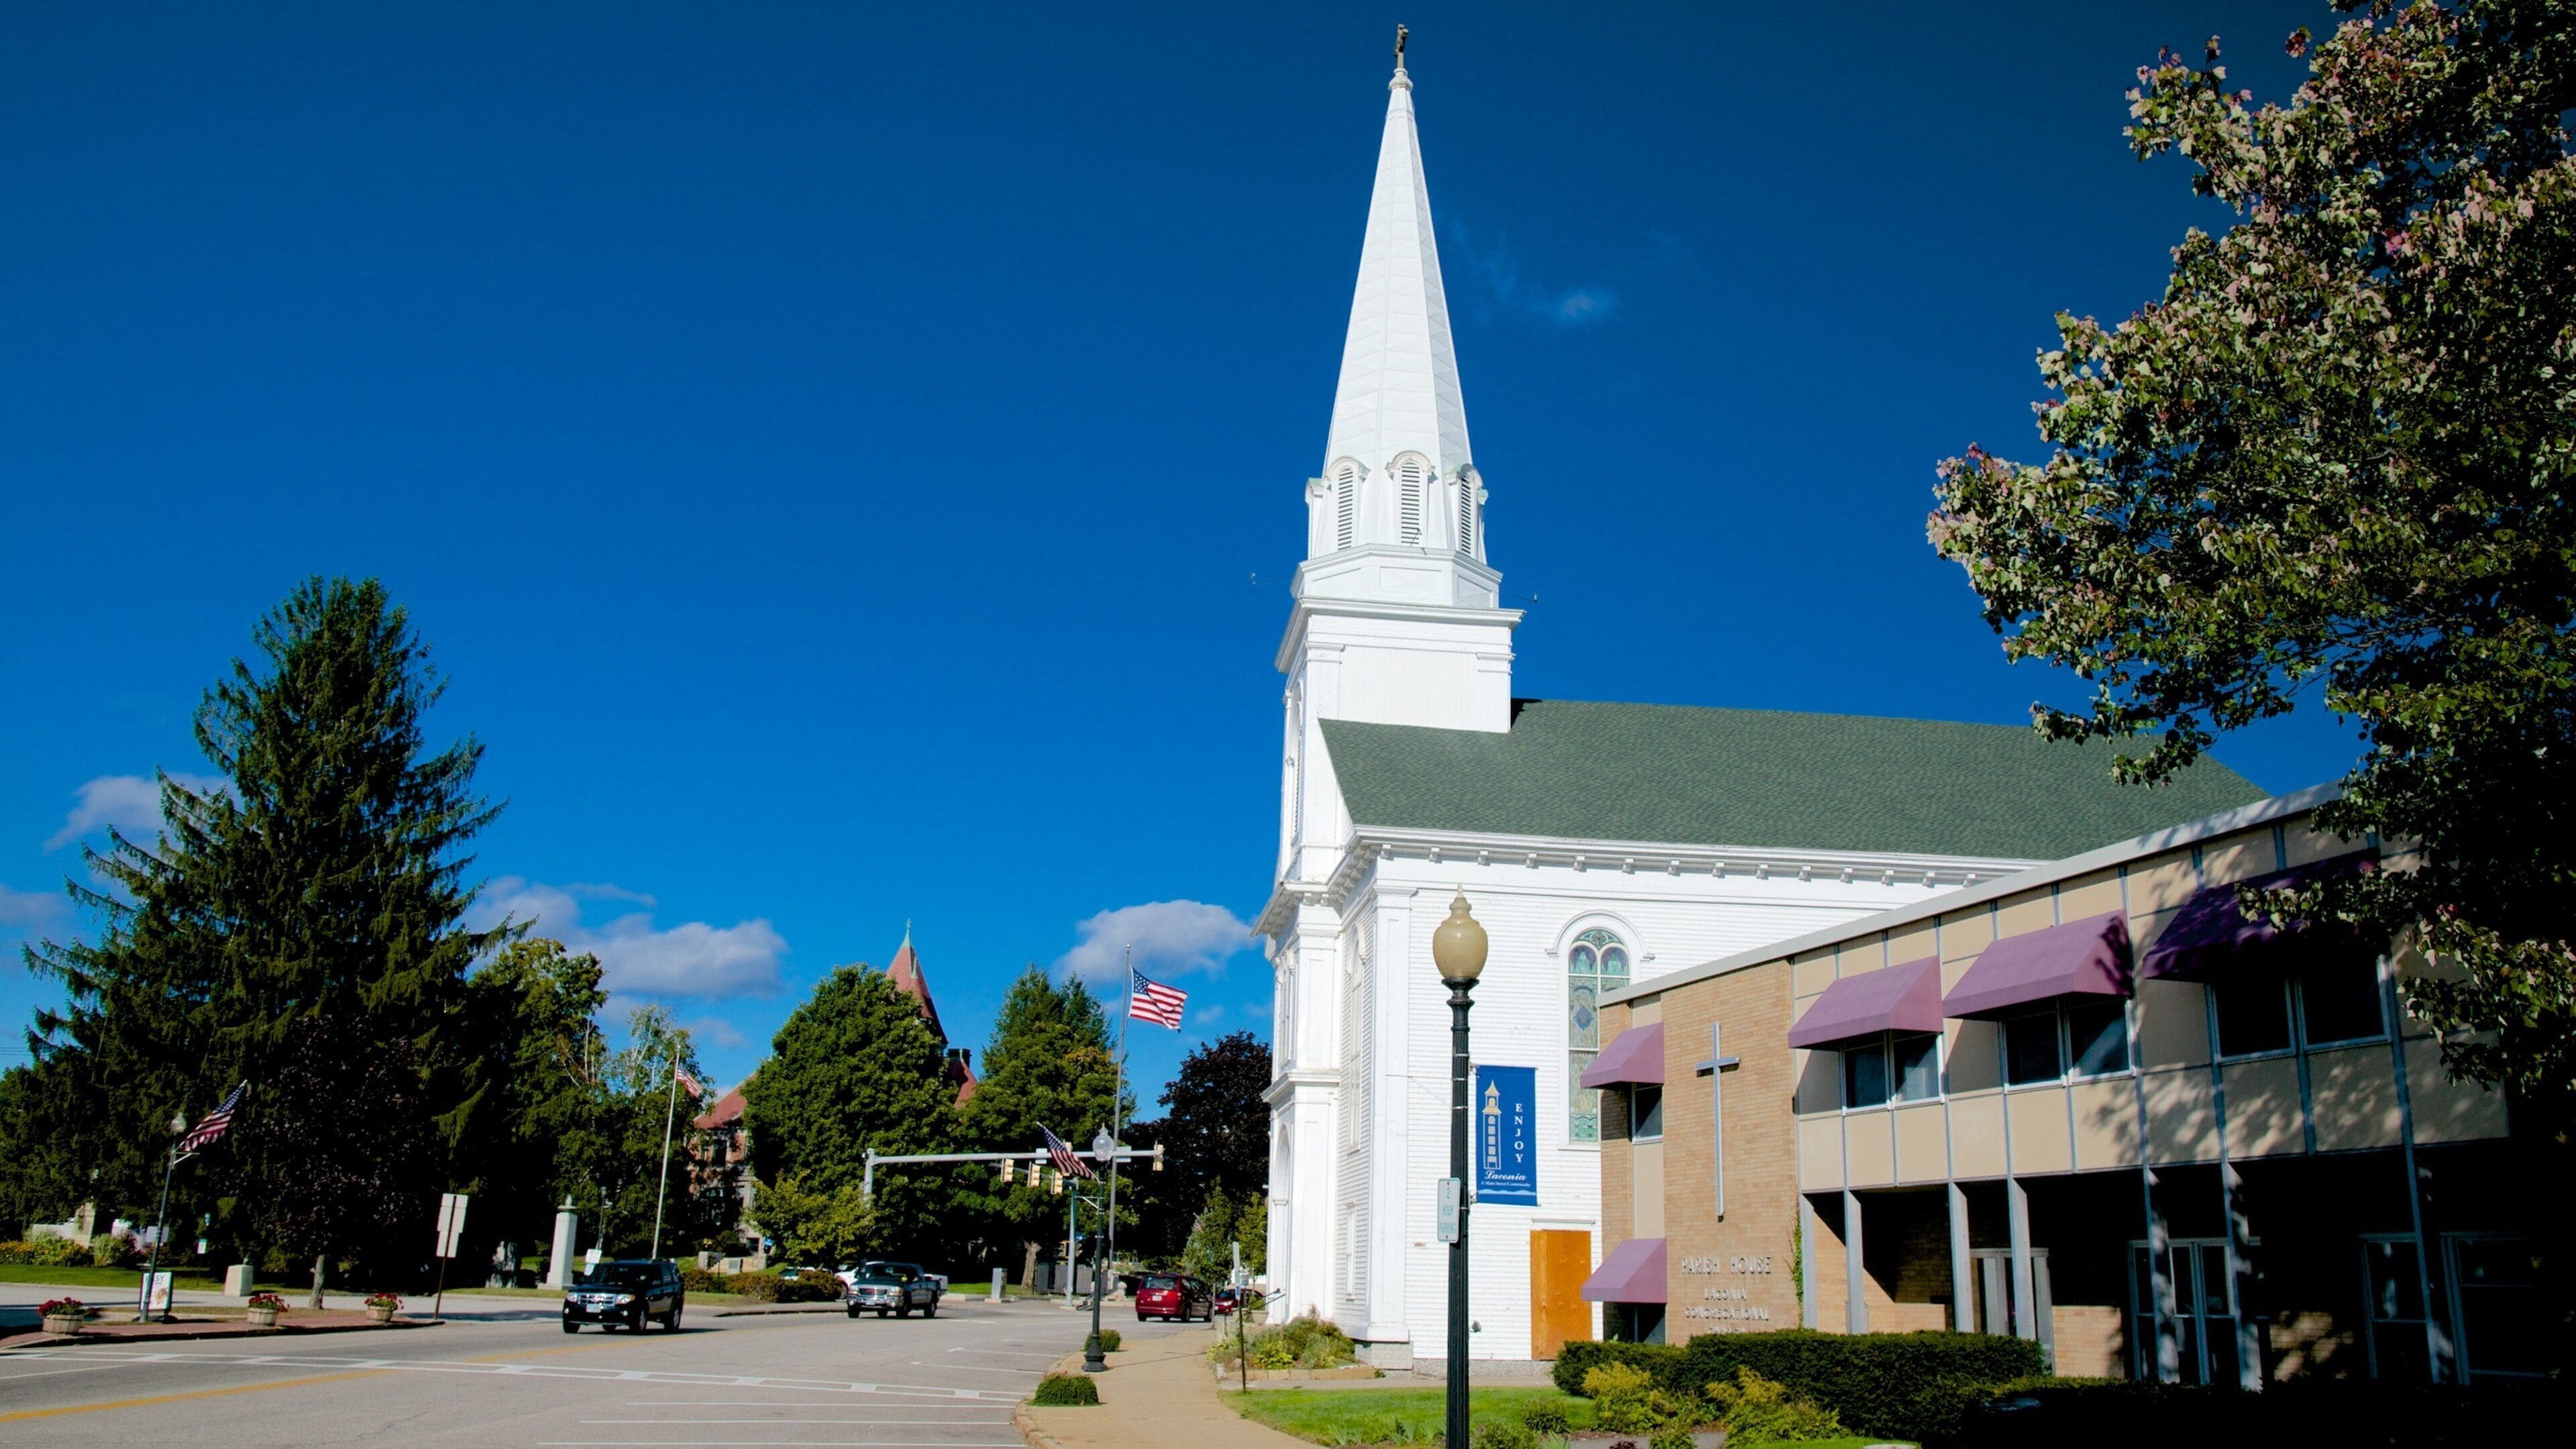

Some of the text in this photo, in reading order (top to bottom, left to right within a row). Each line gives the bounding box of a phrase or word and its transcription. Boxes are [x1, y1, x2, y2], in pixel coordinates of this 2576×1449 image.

[1514, 1103, 1525, 1163] ENJOY
[1484, 1170, 1527, 1181] Laconia
[1446, 1187, 1451, 1199] 2
[1682, 1256, 1771, 1275] PARISH HOUSE
[1705, 1288, 1747, 1301] LACONIA
[1684, 1307, 1770, 1322] CONGREGATIONAL
